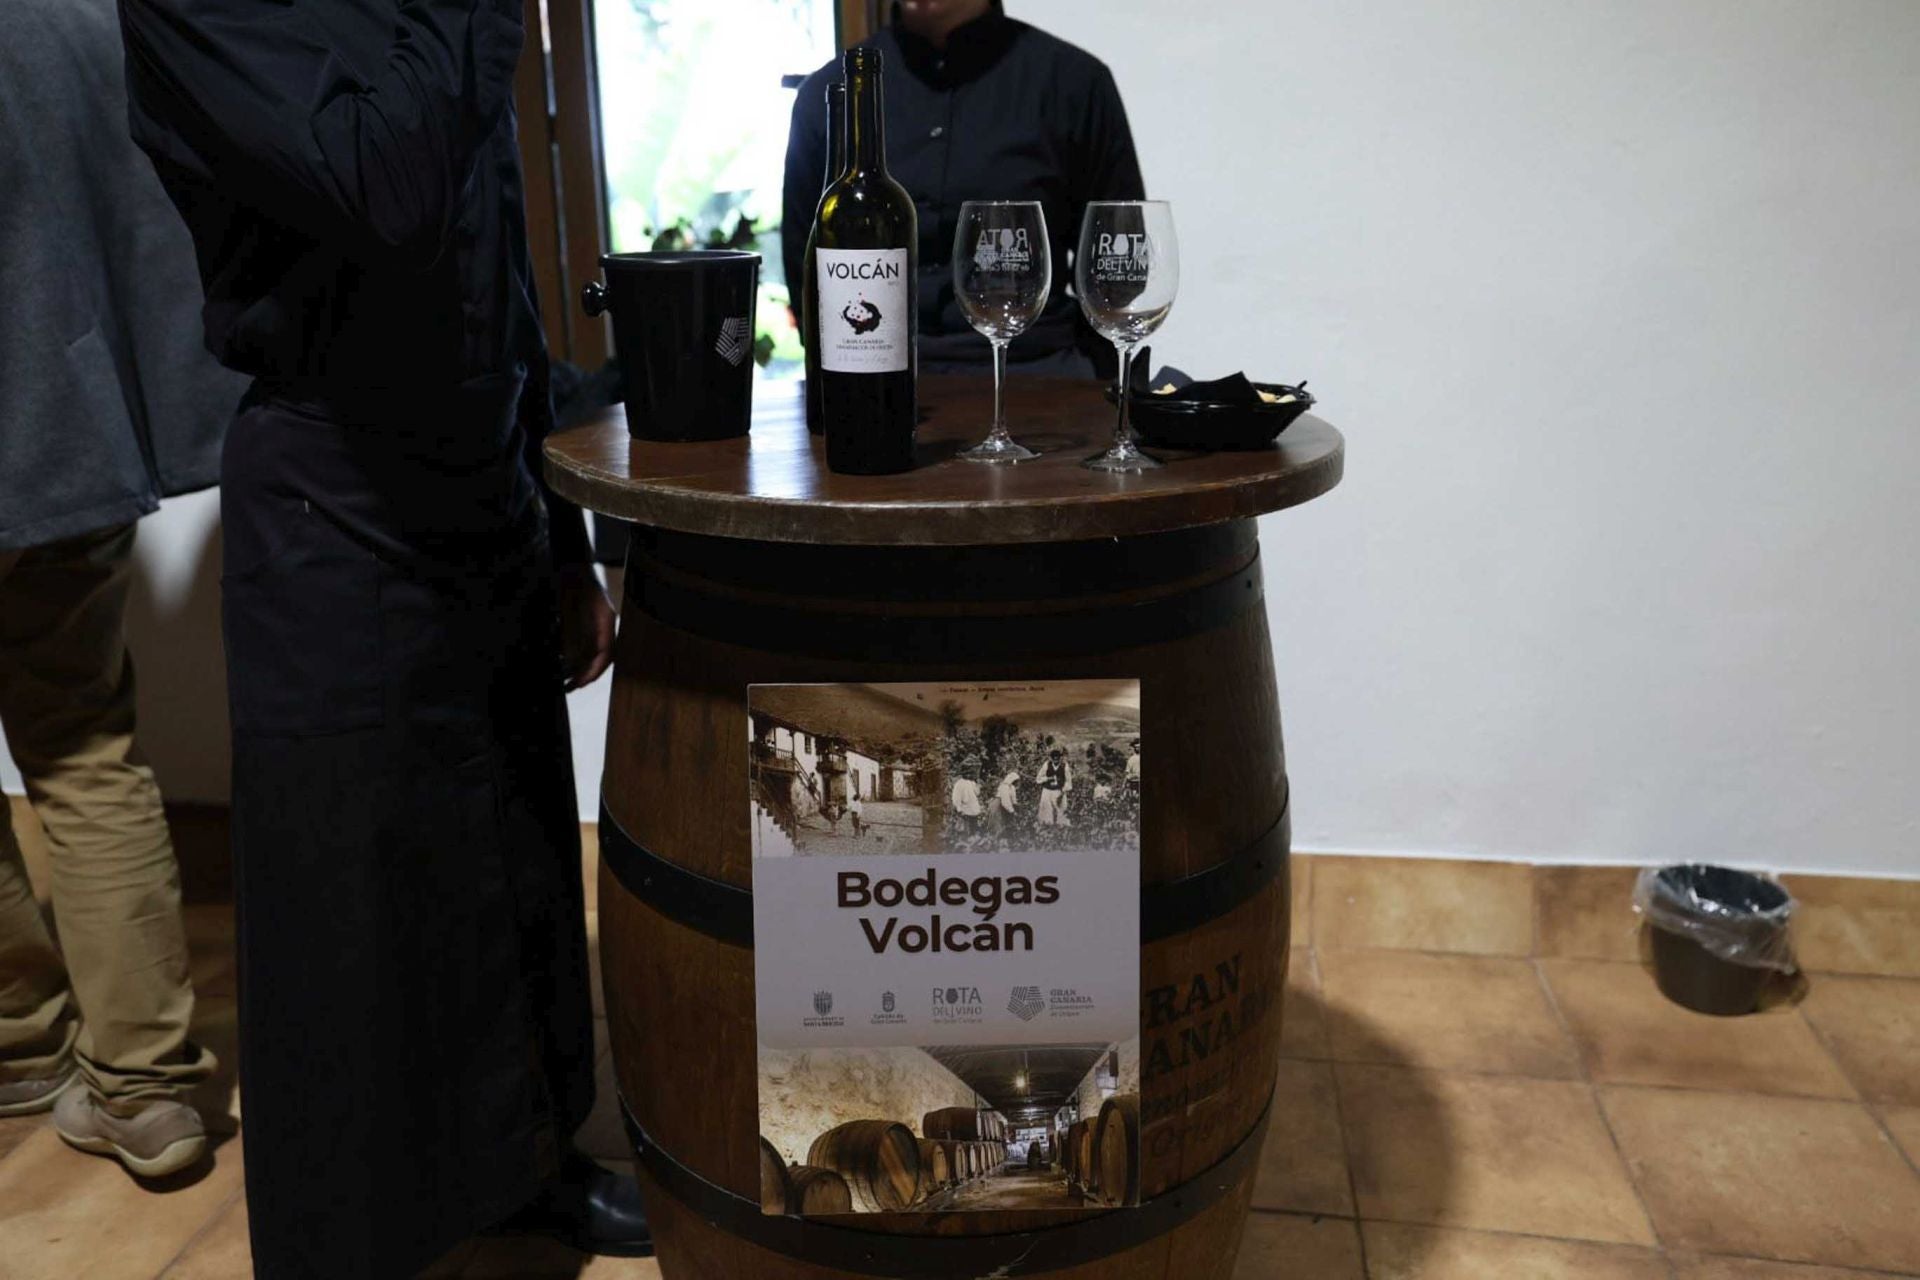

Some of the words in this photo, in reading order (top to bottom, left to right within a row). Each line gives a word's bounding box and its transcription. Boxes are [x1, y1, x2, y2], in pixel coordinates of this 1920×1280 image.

[827, 258, 899, 279] VOLCÁN
[1125, 256, 1149, 271] VIN
[837, 868, 1060, 914] Bodegas
[859, 913, 1034, 953] Volcán
[1145, 951, 1241, 1029] RAN
[956, 1006, 982, 1016] VINO
